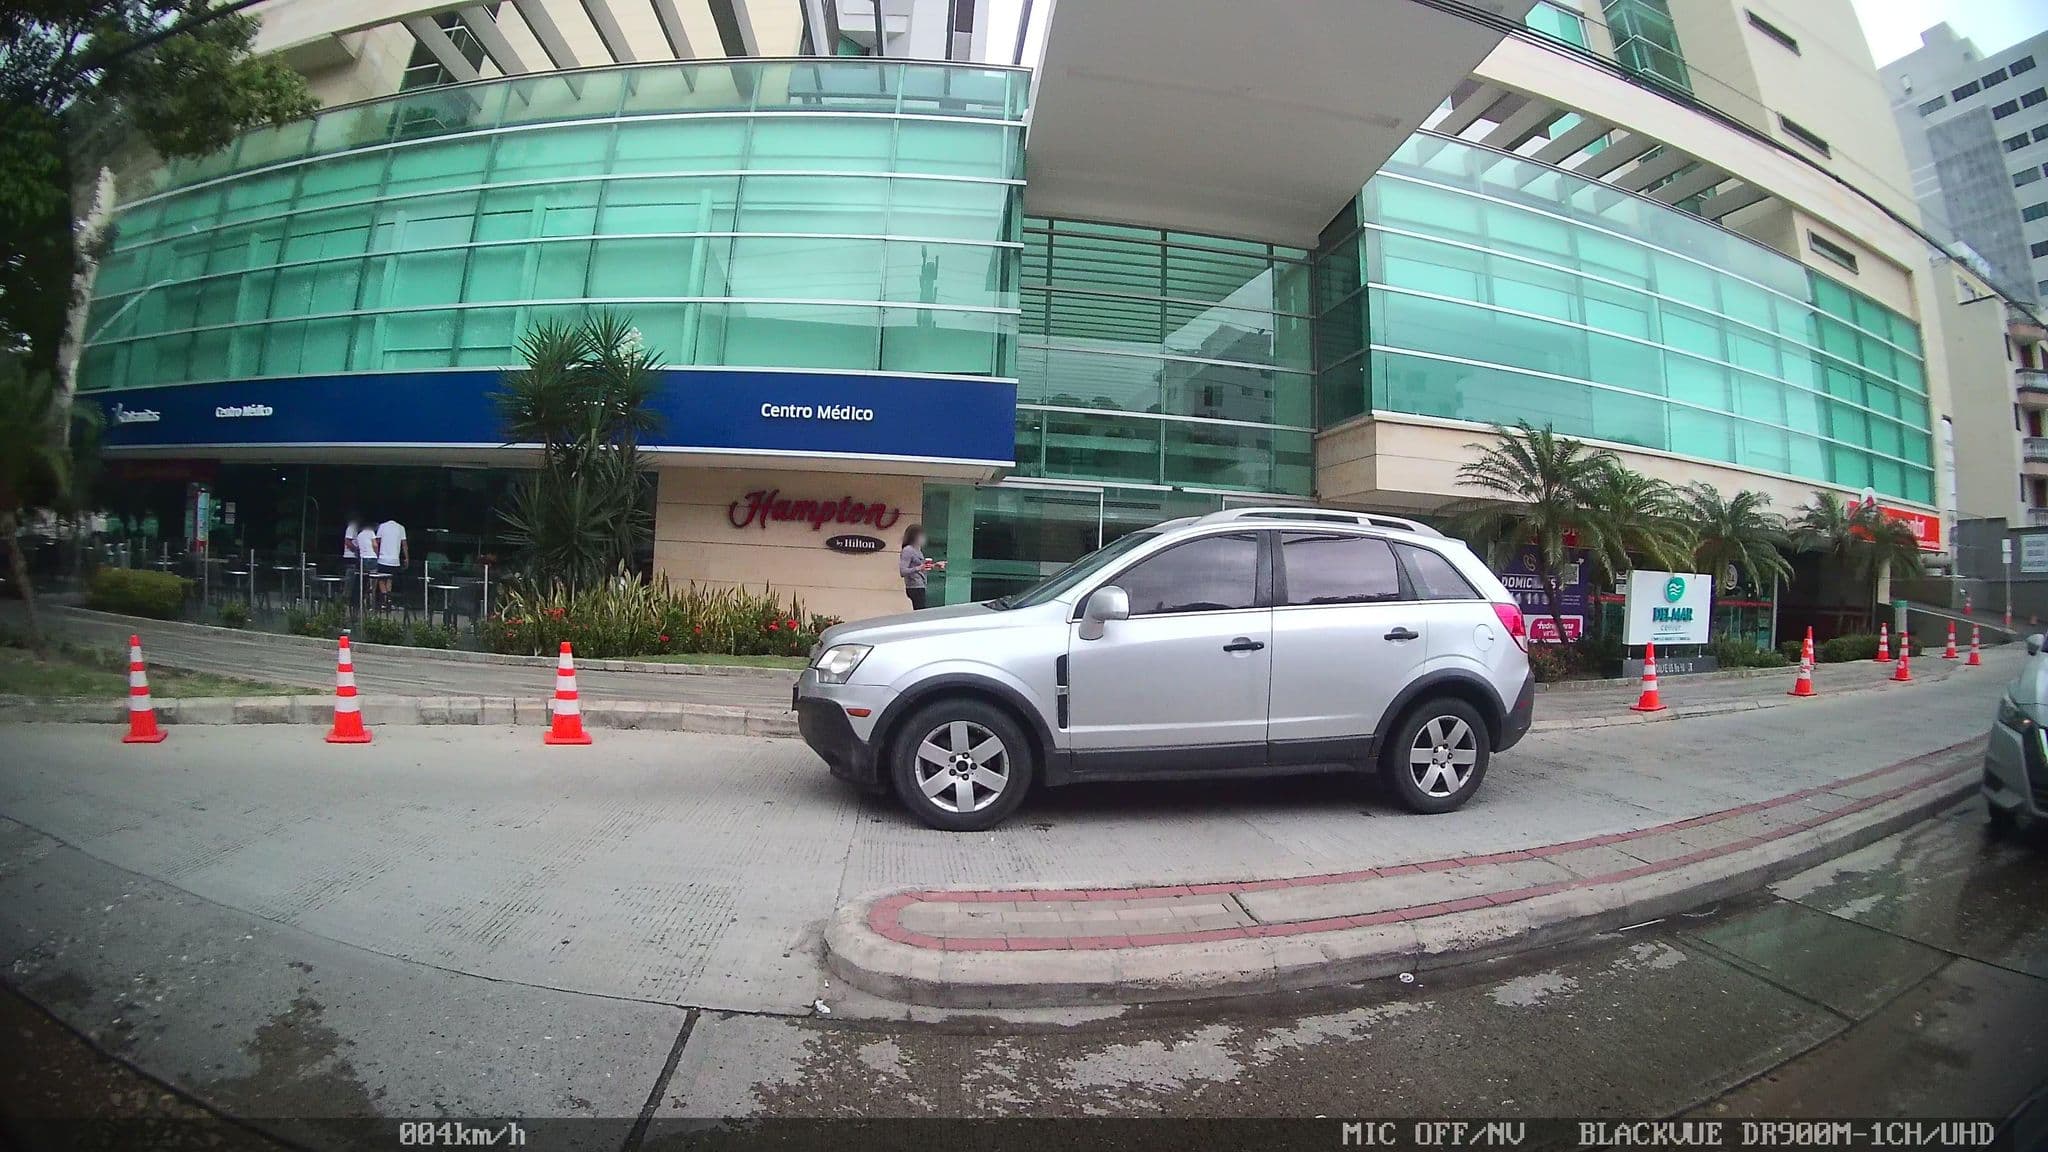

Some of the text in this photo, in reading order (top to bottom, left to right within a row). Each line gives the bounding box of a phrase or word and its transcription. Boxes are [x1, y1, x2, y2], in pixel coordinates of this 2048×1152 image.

[761, 403, 874, 421] Centro Médico
[728, 489, 900, 531] Hampton
[836, 538, 876, 549] by Hilton
[1671, 607, 1694, 621] MAR
